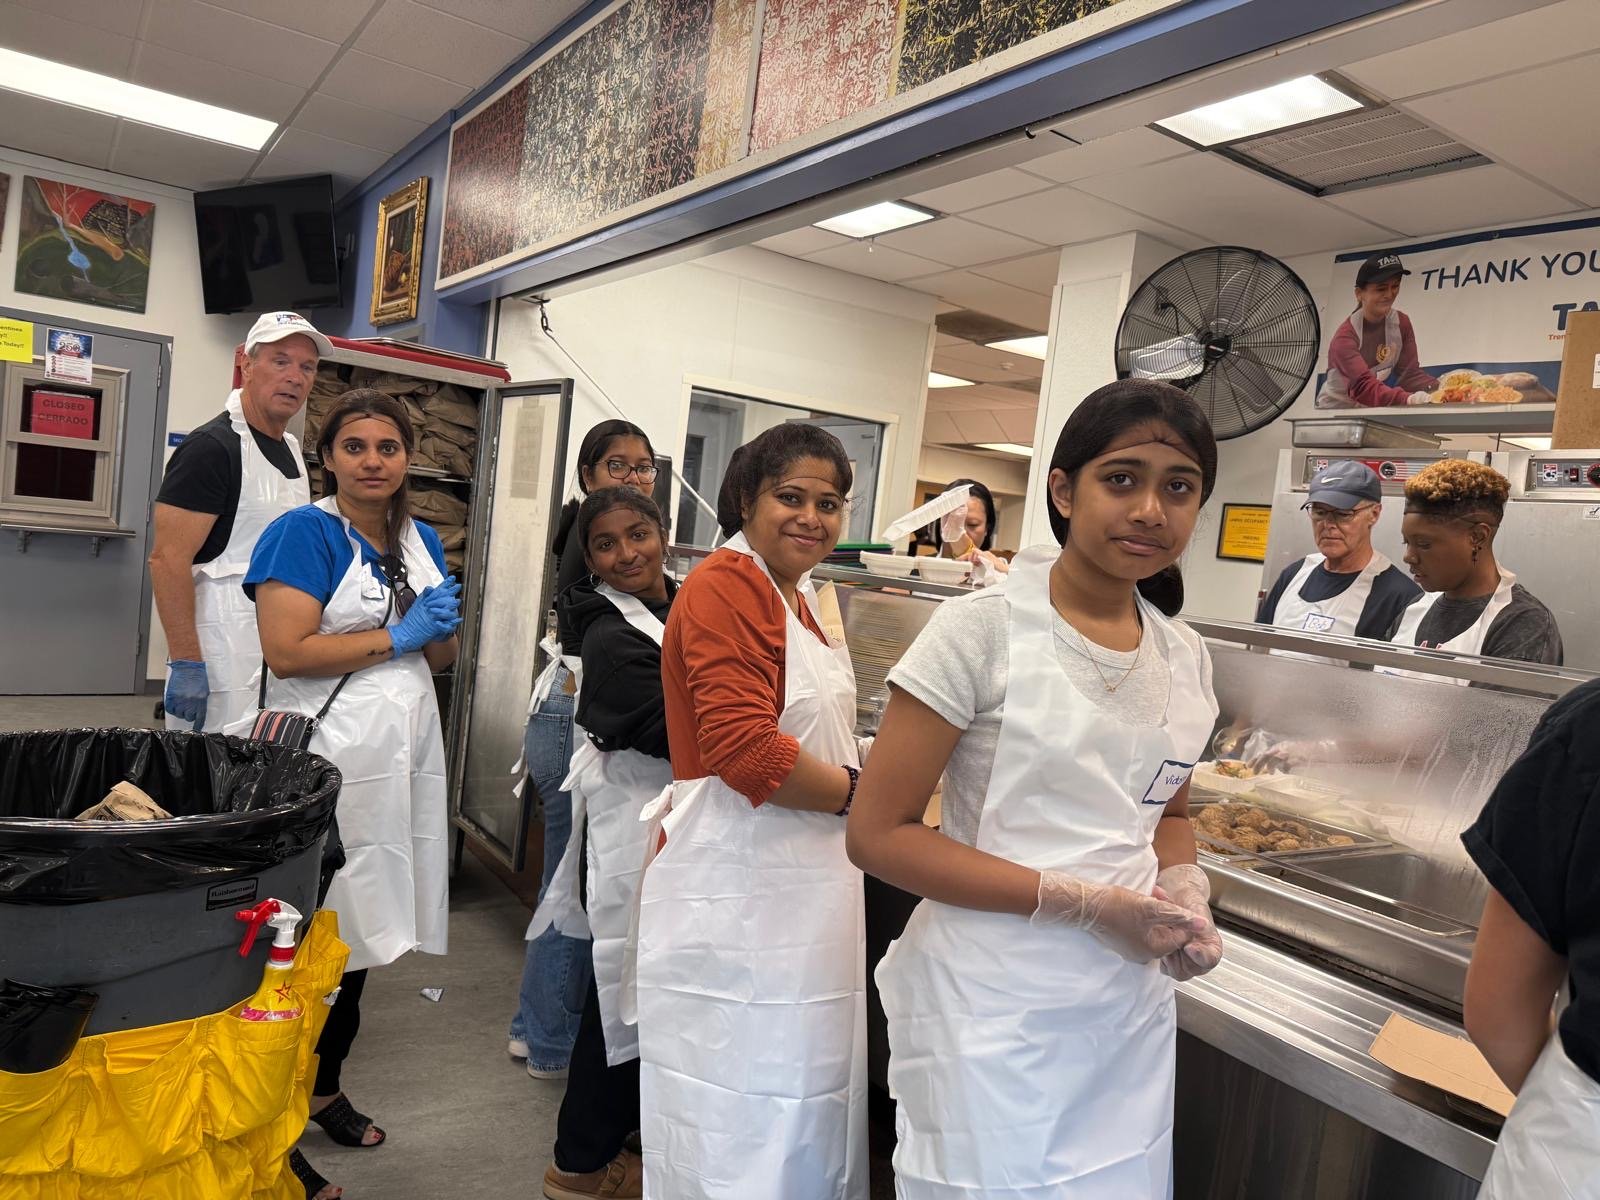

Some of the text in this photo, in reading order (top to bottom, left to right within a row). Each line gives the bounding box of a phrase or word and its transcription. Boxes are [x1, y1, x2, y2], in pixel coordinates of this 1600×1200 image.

[1421, 257, 1531, 291] THANK
[42, 399, 85, 411] CLOSED
[38, 413, 88, 425] CERRADO
